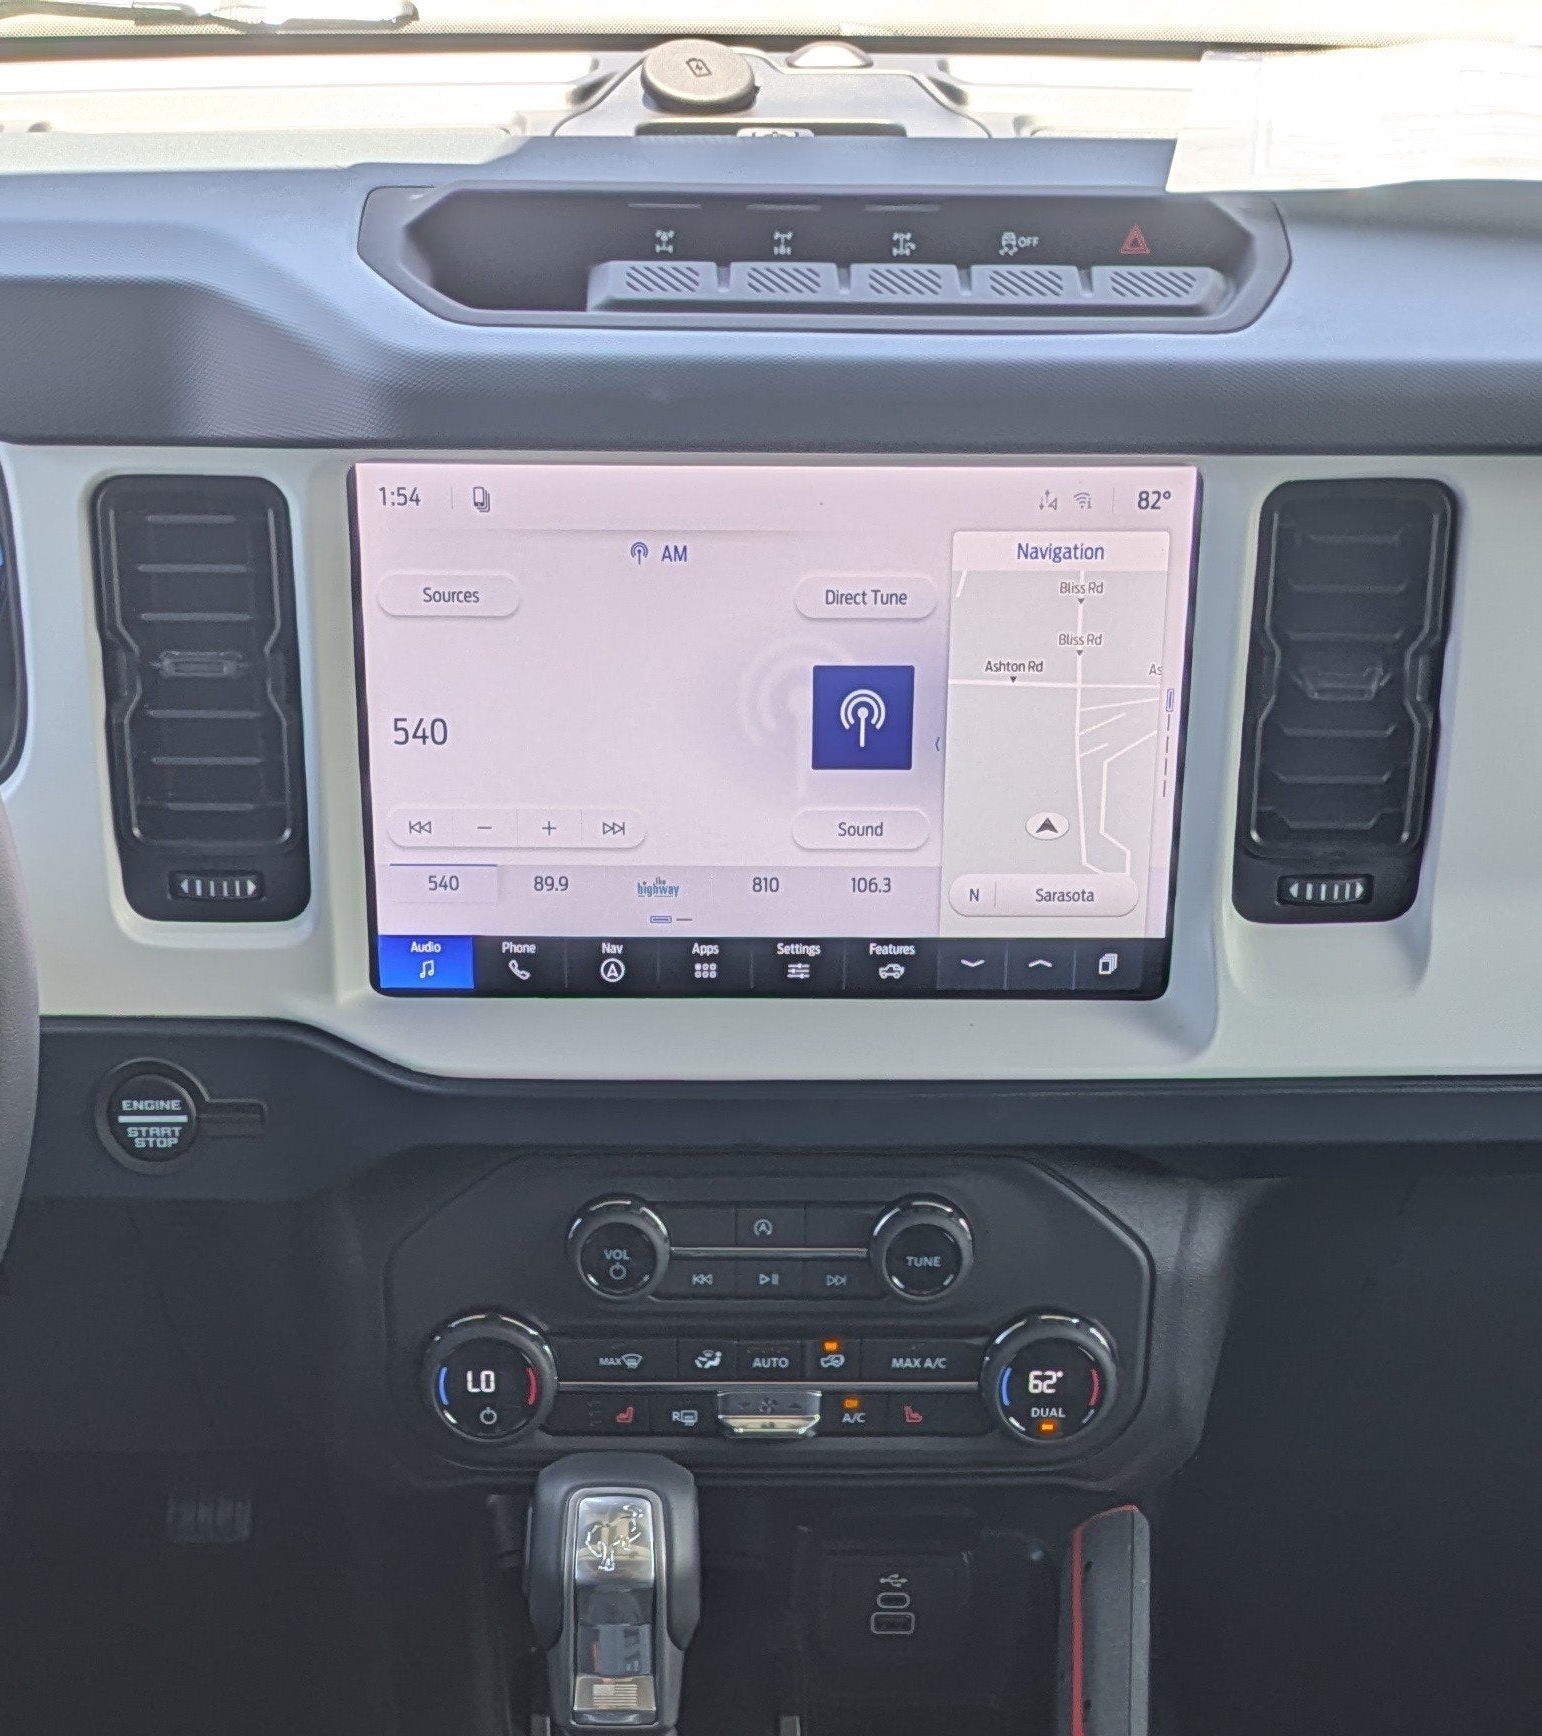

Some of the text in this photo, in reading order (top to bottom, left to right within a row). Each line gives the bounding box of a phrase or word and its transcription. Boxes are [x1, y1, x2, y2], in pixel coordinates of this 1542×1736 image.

[1018, 236, 1039, 248] OFF
[378, 486, 422, 507] 1:54
[1137, 490, 1172, 511] 82°
[661, 545, 688, 563] AM
[1016, 542, 1106, 561] Navigation
[1059, 581, 1104, 595] Bliss Rd
[422, 587, 480, 604] Sources
[824, 589, 908, 606] Direct Tune
[1058, 633, 1103, 647] Bliss Rd
[985, 659, 1044, 674] Ashton Rd
[393, 717, 449, 746] 540
[837, 822, 884, 838] Sound
[428, 875, 569, 892] 540 89.9
[636, 881, 681, 898] highway
[751, 876, 892, 894] 810 106.3
[969, 887, 1095, 904] N Sarasota
[410, 941, 442, 954] Audio
[501, 941, 537, 954] Phone
[601, 942, 624, 954] Nav
[691, 942, 720, 957] Apps
[776, 943, 821, 957] Settings
[869, 943, 916, 956] Features
[121, 1100, 182, 1111] ENGINE
[126, 1126, 183, 1138] START
[134, 1137, 179, 1149] STOP
[603, 1248, 631, 1261] VOL
[906, 1255, 942, 1268] TUNE
[598, 1356, 621, 1367] MAX
[752, 1357, 790, 1369] AUTO
[891, 1357, 948, 1370] MAX A/C
[466, 1370, 496, 1394] LO
[671, 1411, 680, 1422] R
[841, 1411, 867, 1425] A/C
[1030, 1406, 1066, 1419] DUAL
